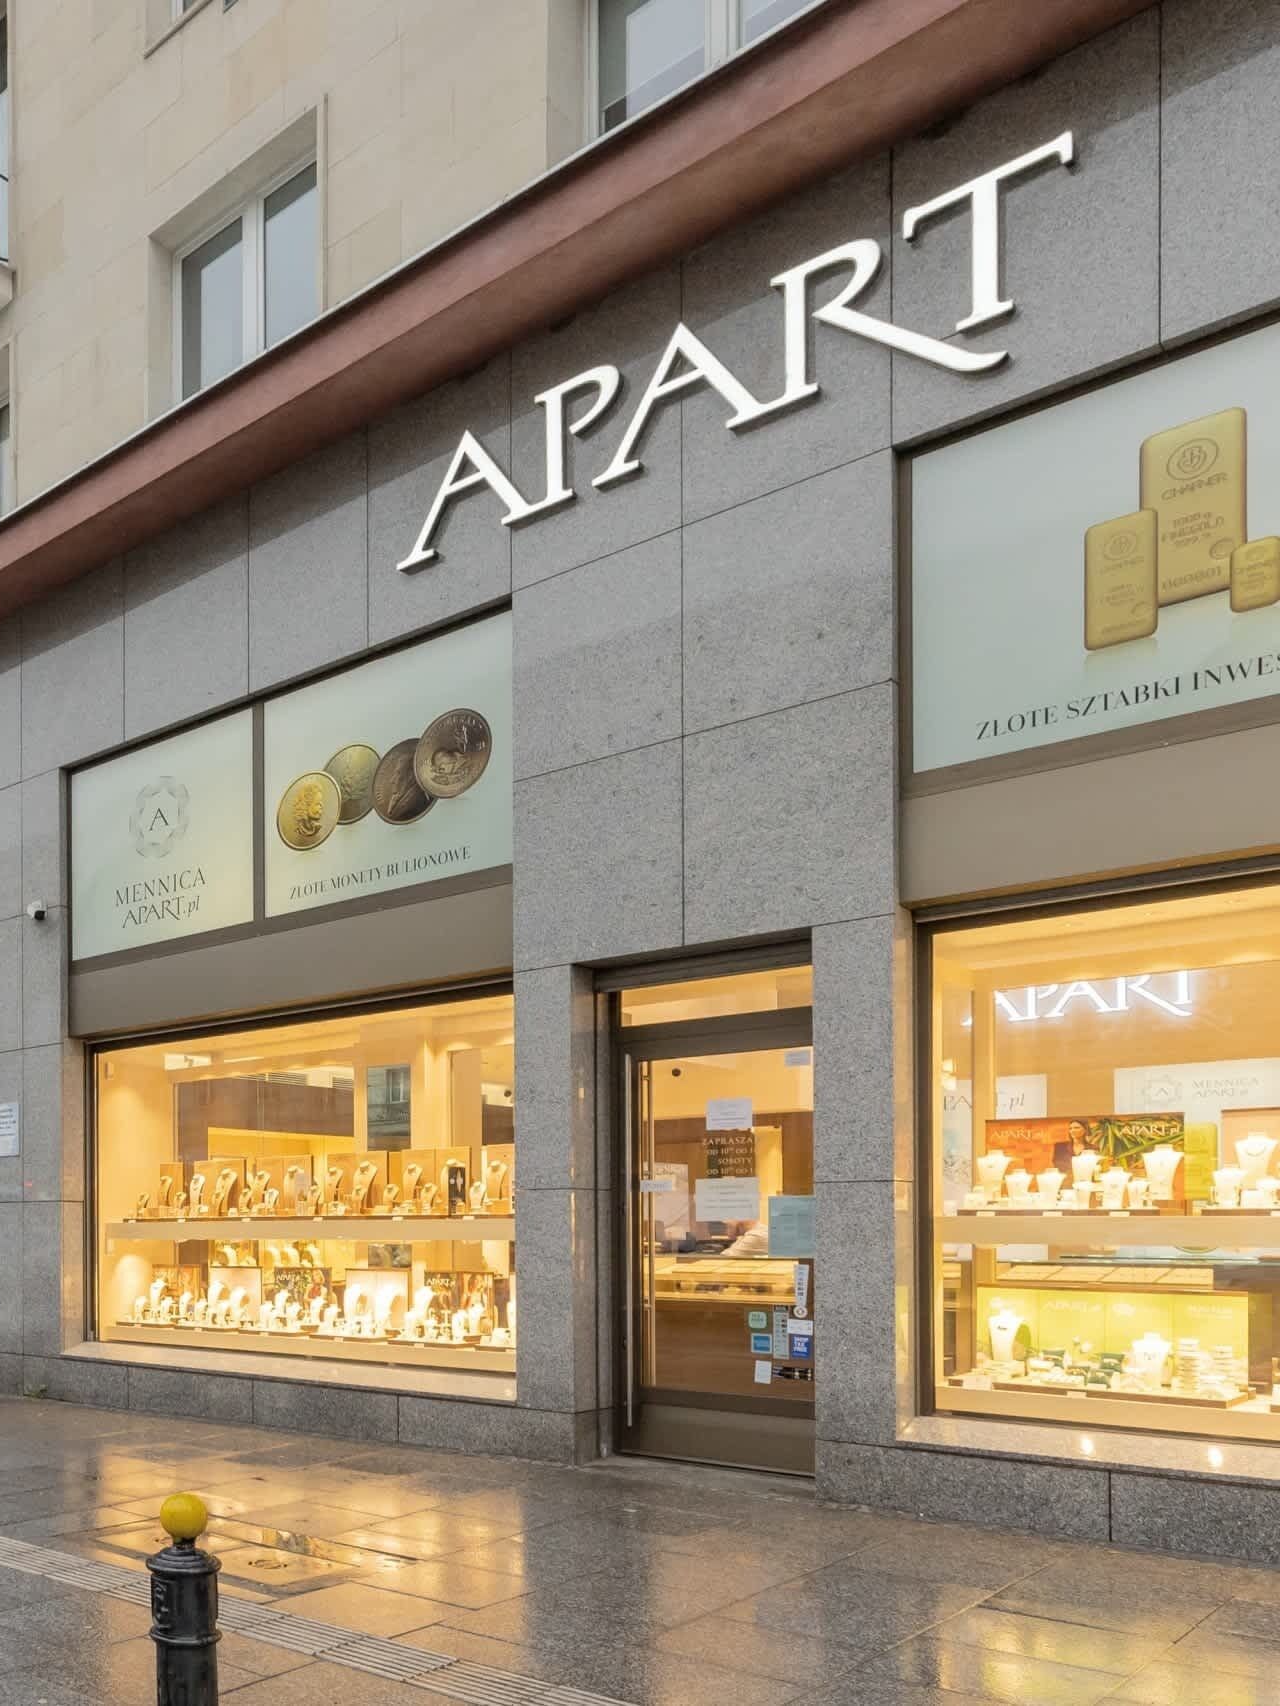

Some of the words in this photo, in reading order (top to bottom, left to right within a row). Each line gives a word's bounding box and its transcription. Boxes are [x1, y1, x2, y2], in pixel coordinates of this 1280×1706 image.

[397, 131, 1072, 572] APART
[976, 705, 1058, 740] ZŁOTE
[1066, 676, 1181, 720] SZTABKI
[115, 867, 205, 907] MENNICA
[330, 866, 384, 890] MONETY
[386, 846, 471, 878] BULIONOWE
[122, 895, 200, 928] APART.pl
